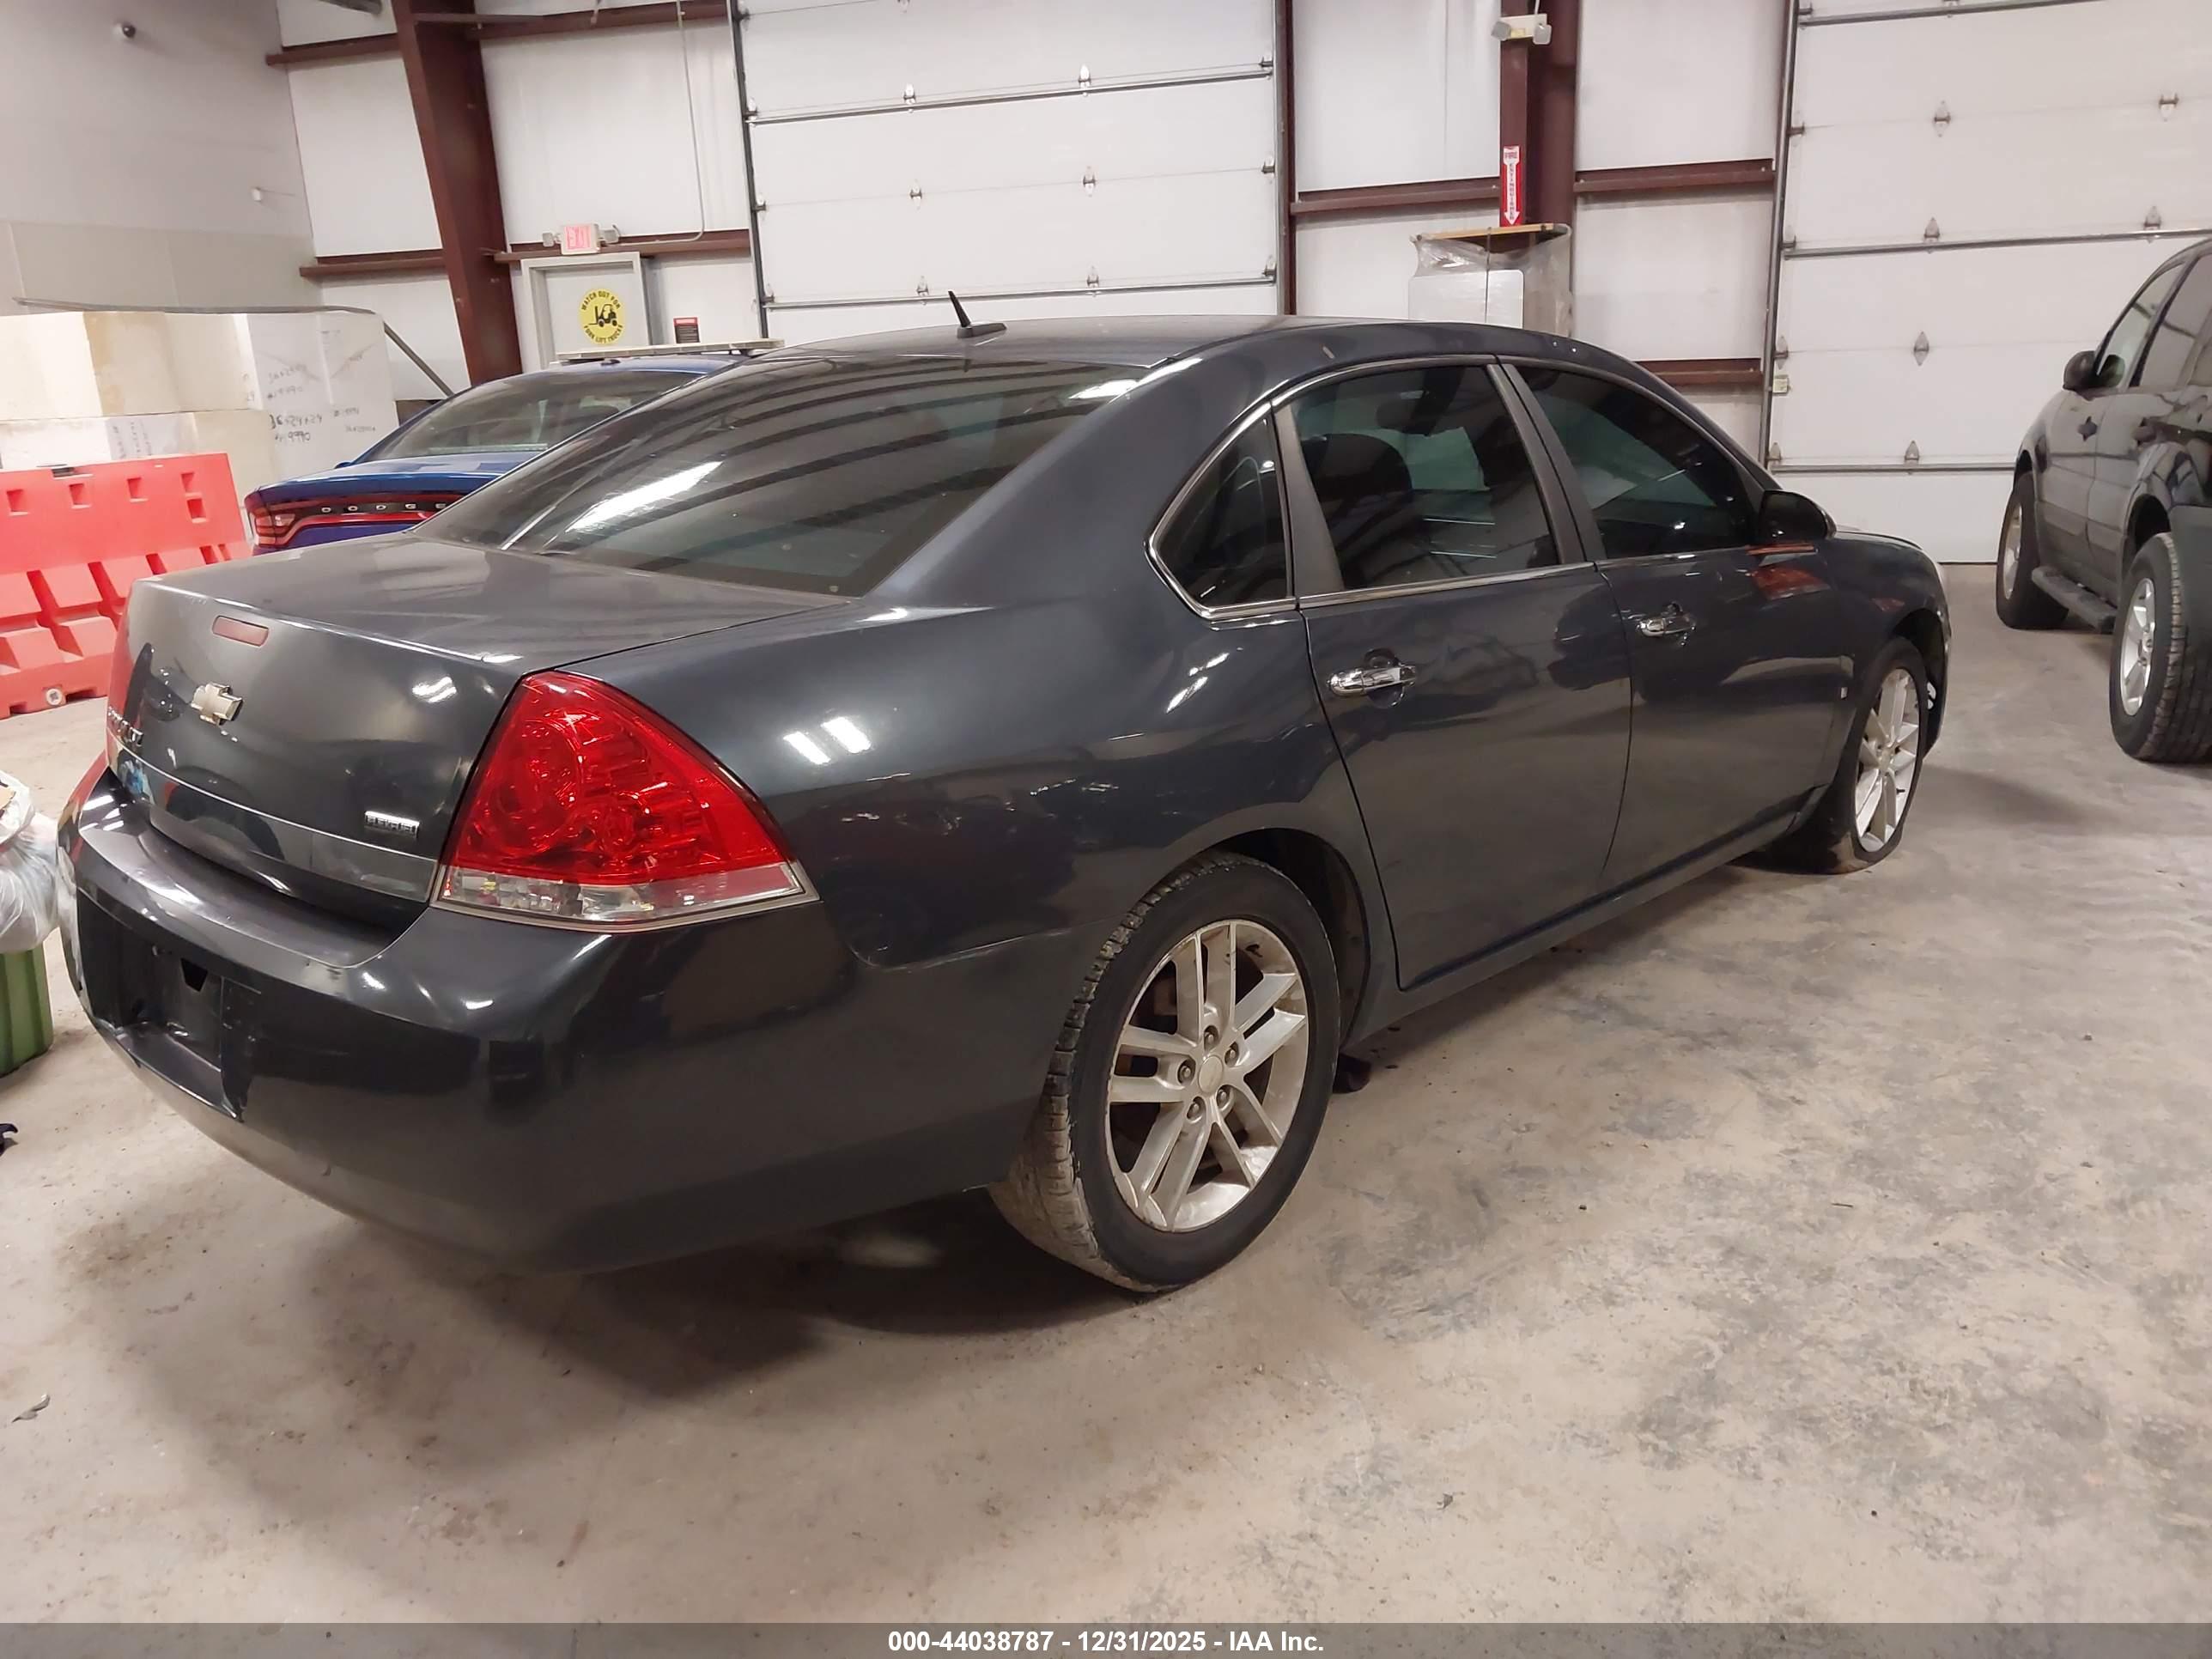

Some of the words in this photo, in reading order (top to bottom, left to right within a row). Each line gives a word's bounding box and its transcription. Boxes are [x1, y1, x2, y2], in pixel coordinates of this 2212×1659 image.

[580, 291, 598, 311] WATCH
[598, 290, 611, 299] OUT
[610, 295, 621, 310] FOR
[583, 325, 595, 340] FORK
[321, 502, 447, 514] DODGE
